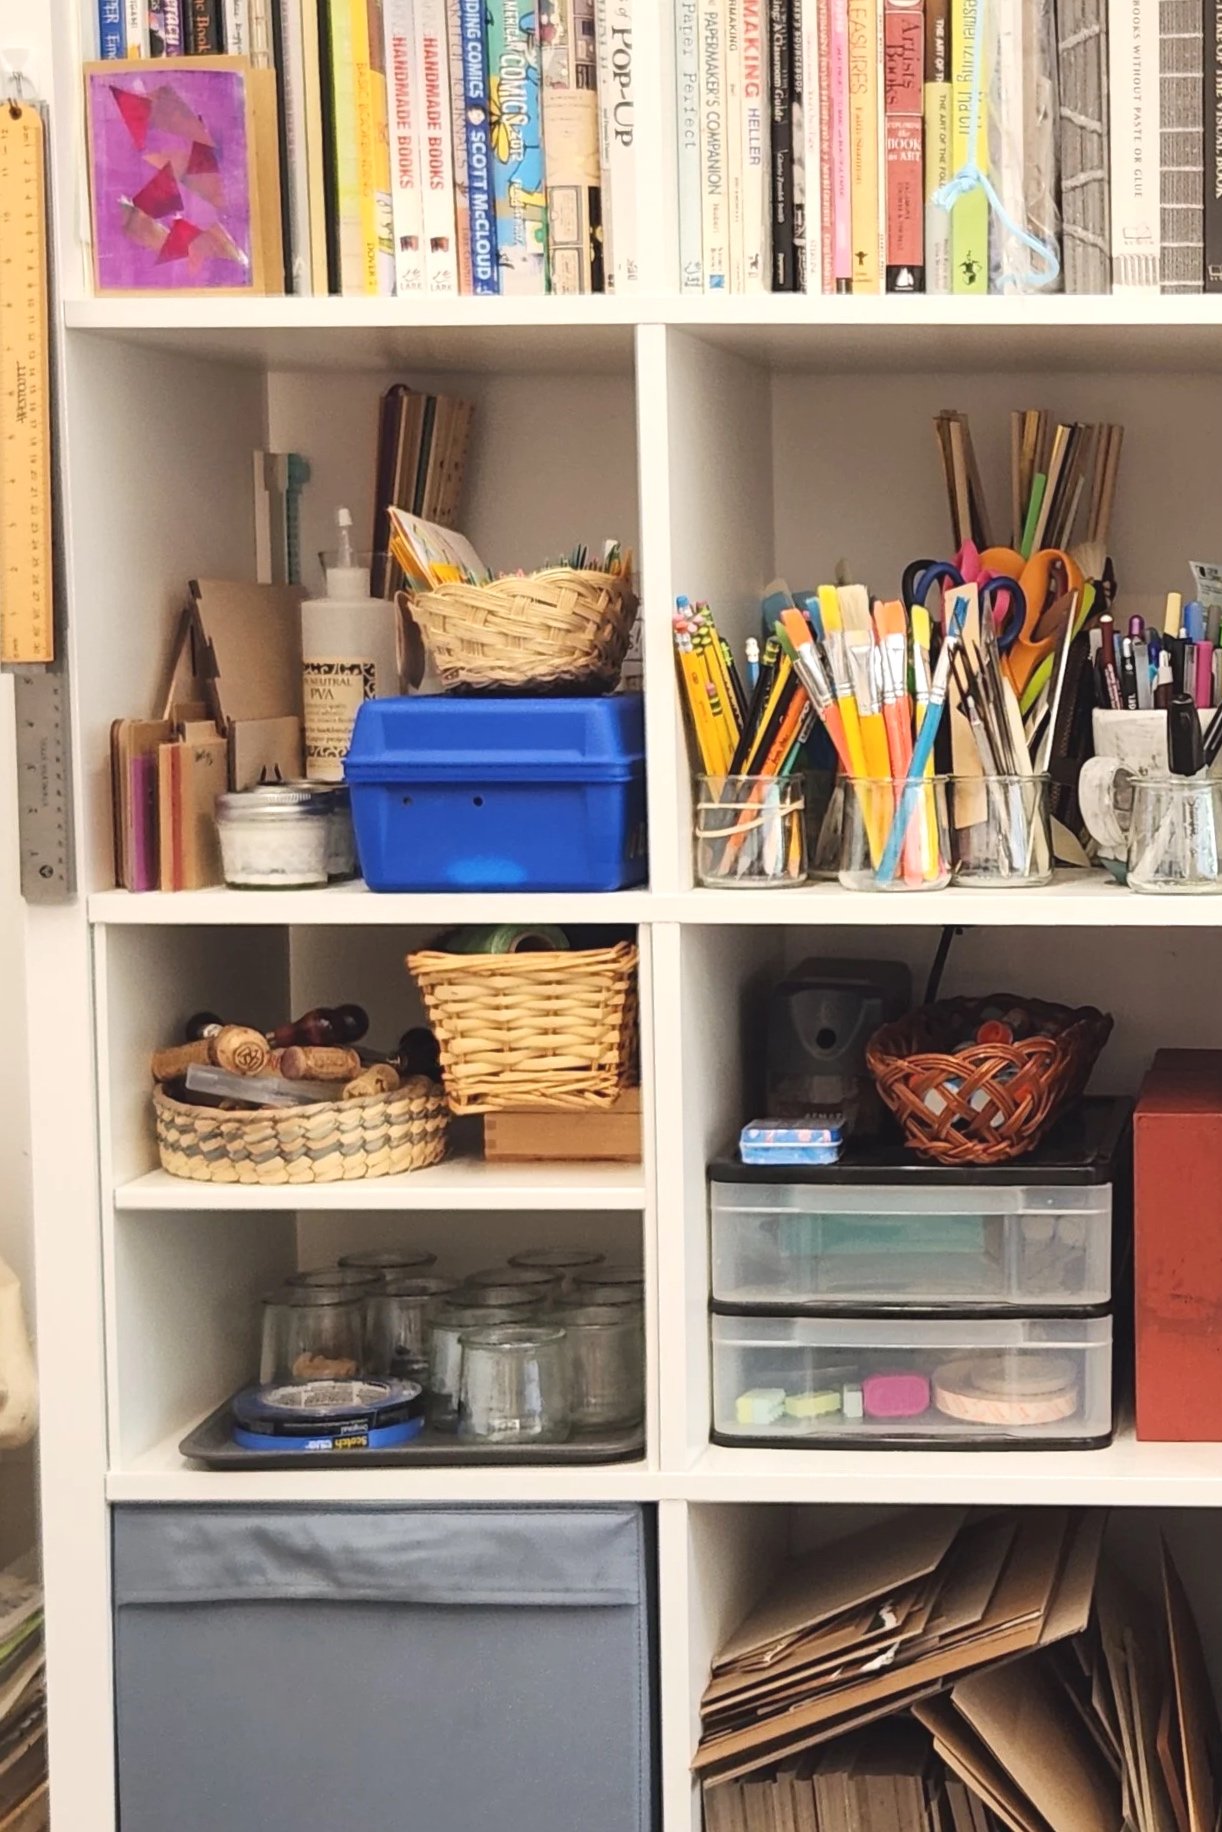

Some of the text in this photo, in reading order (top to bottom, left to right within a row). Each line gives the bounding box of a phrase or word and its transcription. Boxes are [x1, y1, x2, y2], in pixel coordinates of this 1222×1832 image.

[679, 3, 699, 151] Paper Perfect
[705, 12, 720, 107] PAPERMAKER'S
[886, 45, 906, 105] Books
[936, 18, 944, 70] THE ART OF
[499, 54, 529, 126] COMICS
[774, 33, 785, 123] Classroom Guide
[939, 94, 947, 110] THE
[393, 36, 414, 189] HANDMADE BOOKS
[423, 37, 443, 190] HANDMADE BOOKS
[748, 108, 761, 166] HELLER
[887, 138, 921, 150] BOOK
[939, 133, 946, 147] OF
[1133, 44, 1143, 200] WITHOUT PASTE OR GLUE
[468, 42, 491, 280] COMICS SCOTT McCLOUD
[706, 111, 722, 195] COMPANION
[899, 151, 921, 161] ART
[310, 688, 335, 700] PVA
[334, 1435, 368, 1448] Scotch
